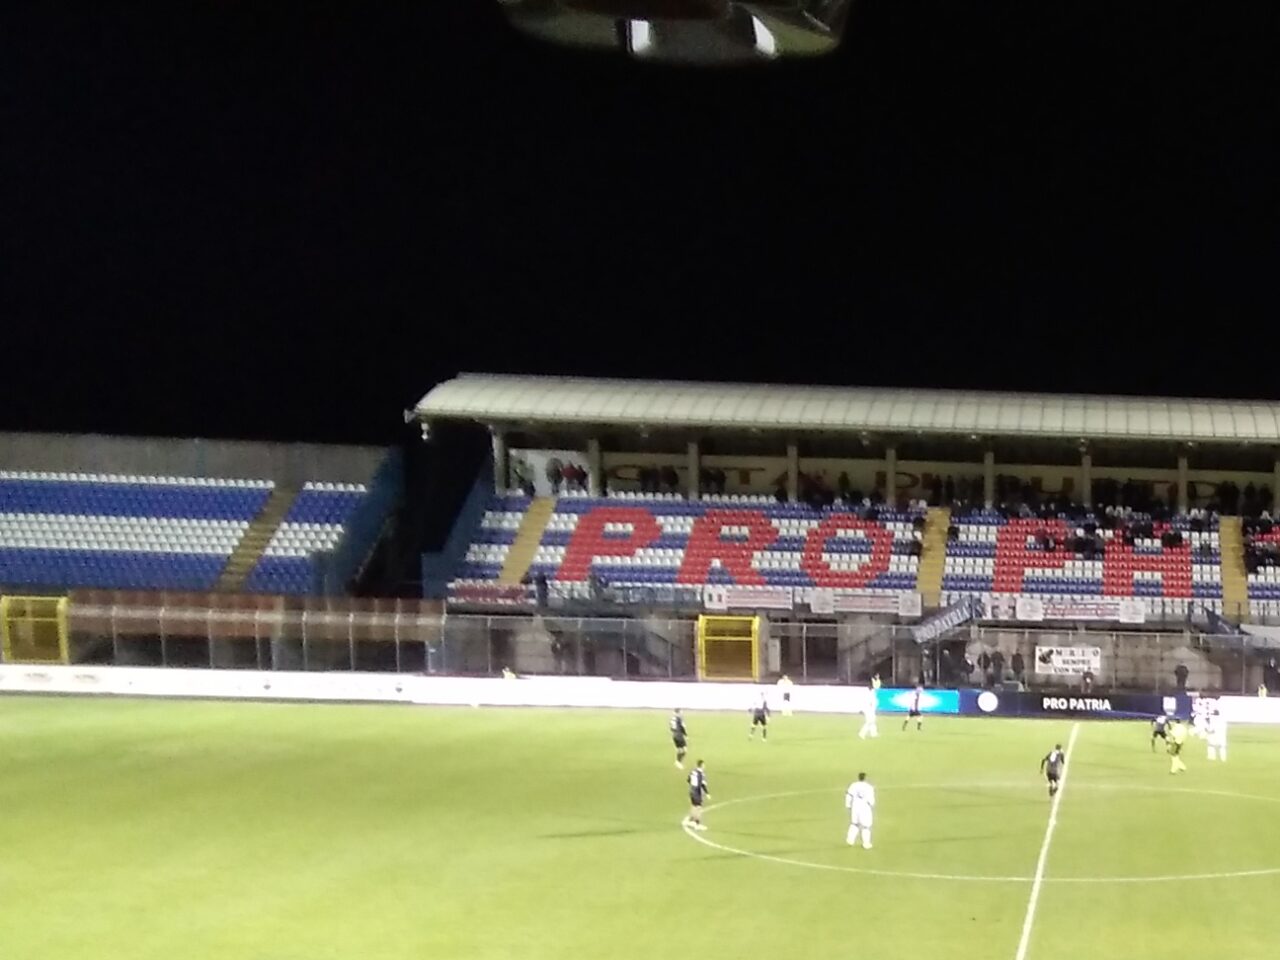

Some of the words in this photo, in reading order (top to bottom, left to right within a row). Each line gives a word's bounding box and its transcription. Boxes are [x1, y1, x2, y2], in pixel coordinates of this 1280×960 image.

[554, 507, 895, 588] PRO
[1043, 697, 1068, 711] PRO
[1069, 698, 1111, 712] PATRIA
